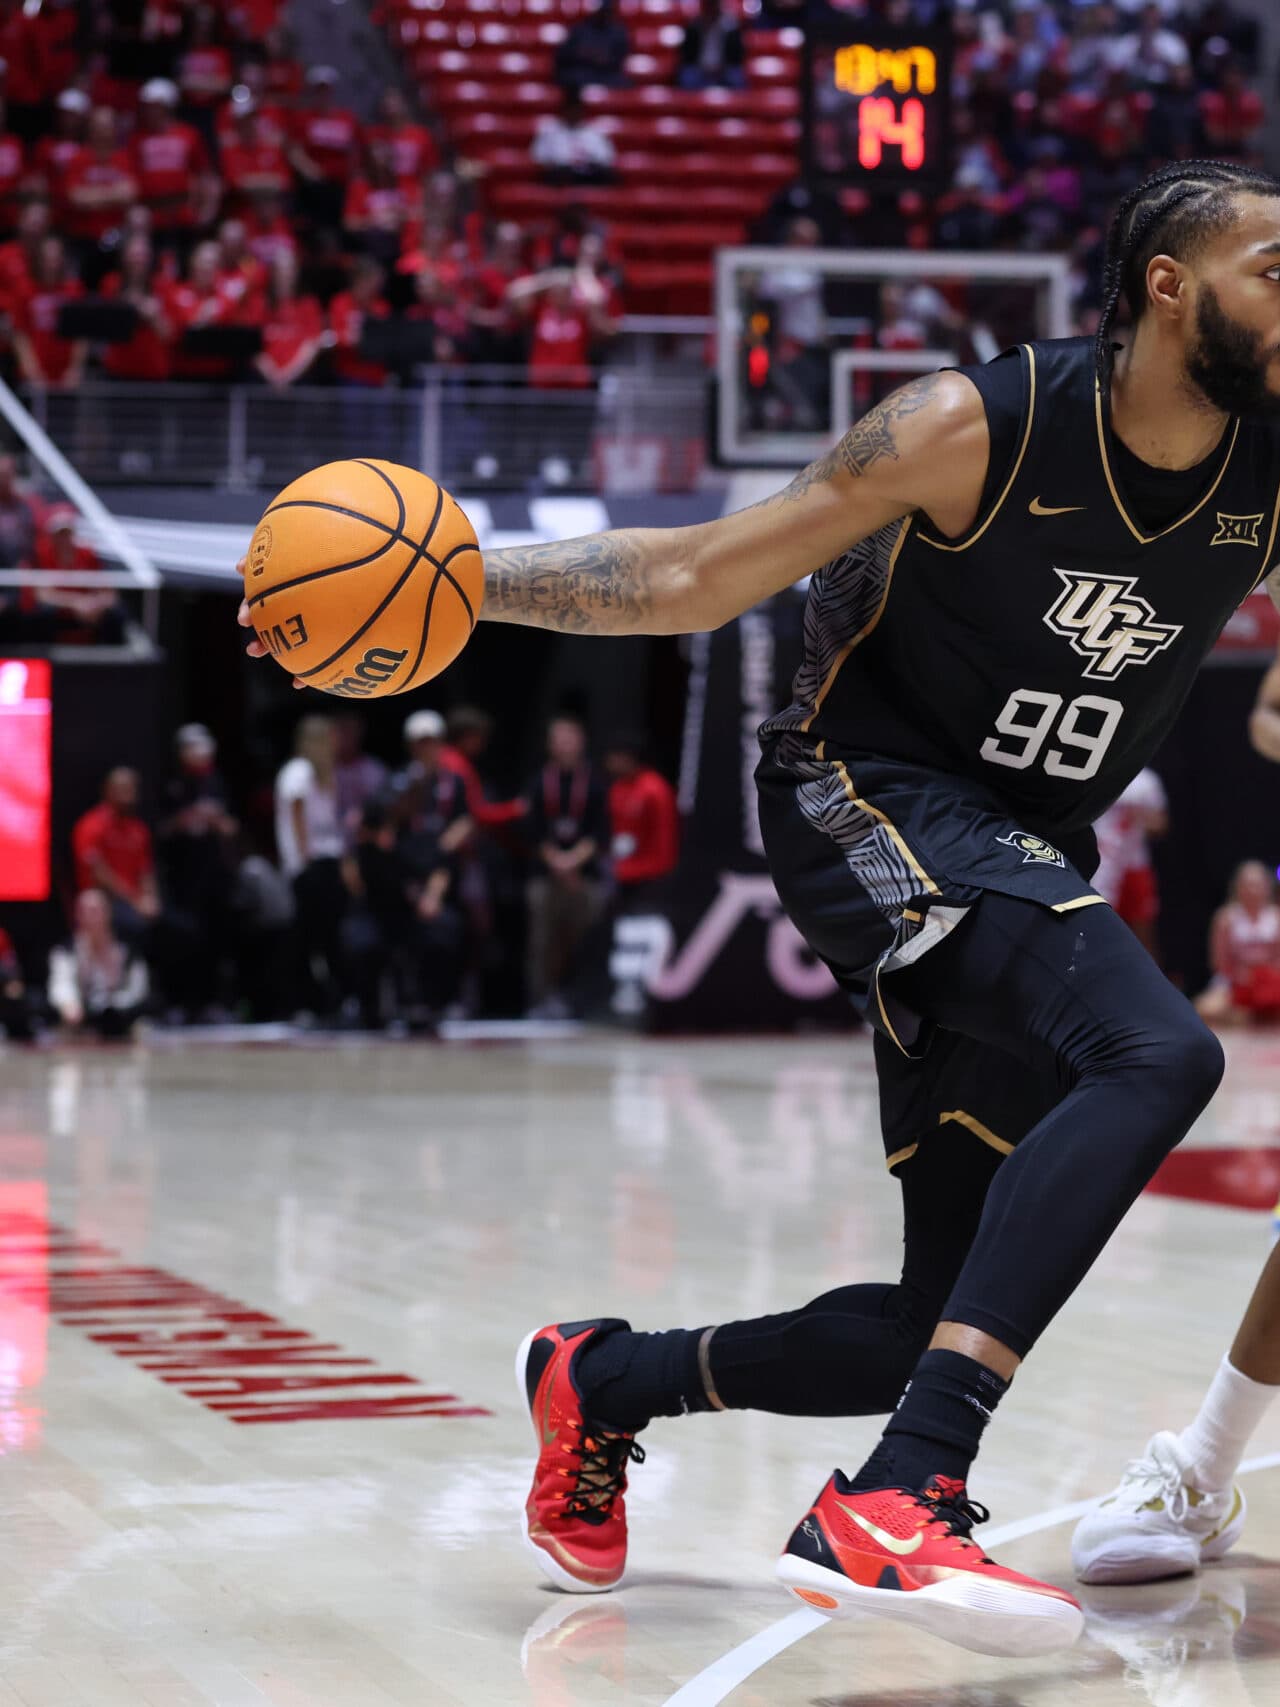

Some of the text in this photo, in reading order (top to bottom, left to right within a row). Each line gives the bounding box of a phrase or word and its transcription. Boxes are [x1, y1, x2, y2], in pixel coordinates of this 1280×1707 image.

[858, 96, 925, 170] 14
[1213, 514, 1261, 545] XII
[1046, 570, 1181, 679] UCF
[980, 688, 1124, 781] 99
